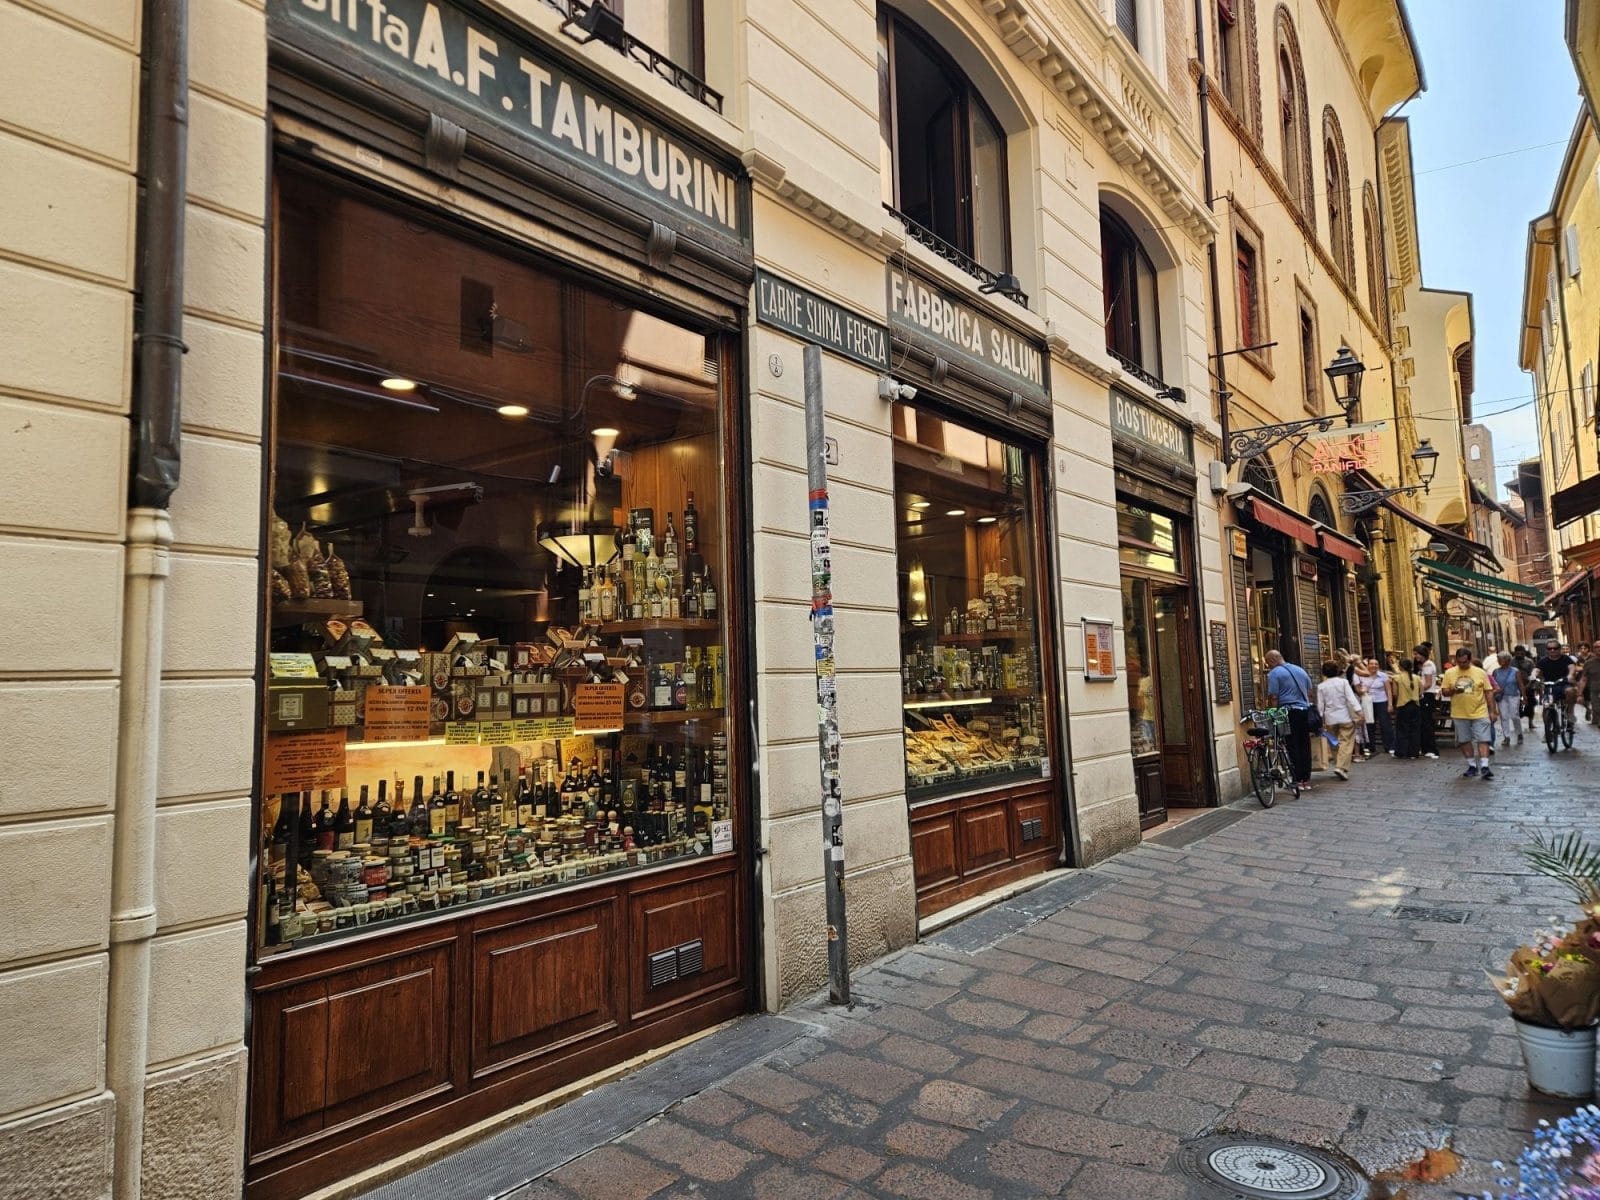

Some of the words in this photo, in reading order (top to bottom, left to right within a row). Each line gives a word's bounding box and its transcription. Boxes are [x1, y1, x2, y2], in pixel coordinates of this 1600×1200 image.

[302, 0, 410, 59] tta
[519, 56, 736, 230] TAMBURINI
[761, 278, 803, 328] CARNE
[806, 298, 842, 346] SUINA
[846, 316, 887, 365] FRESCA
[888, 270, 984, 357] FABBRICA
[990, 328, 1043, 386] SALUMI
[1116, 396, 1185, 456] ROSTICCERIA
